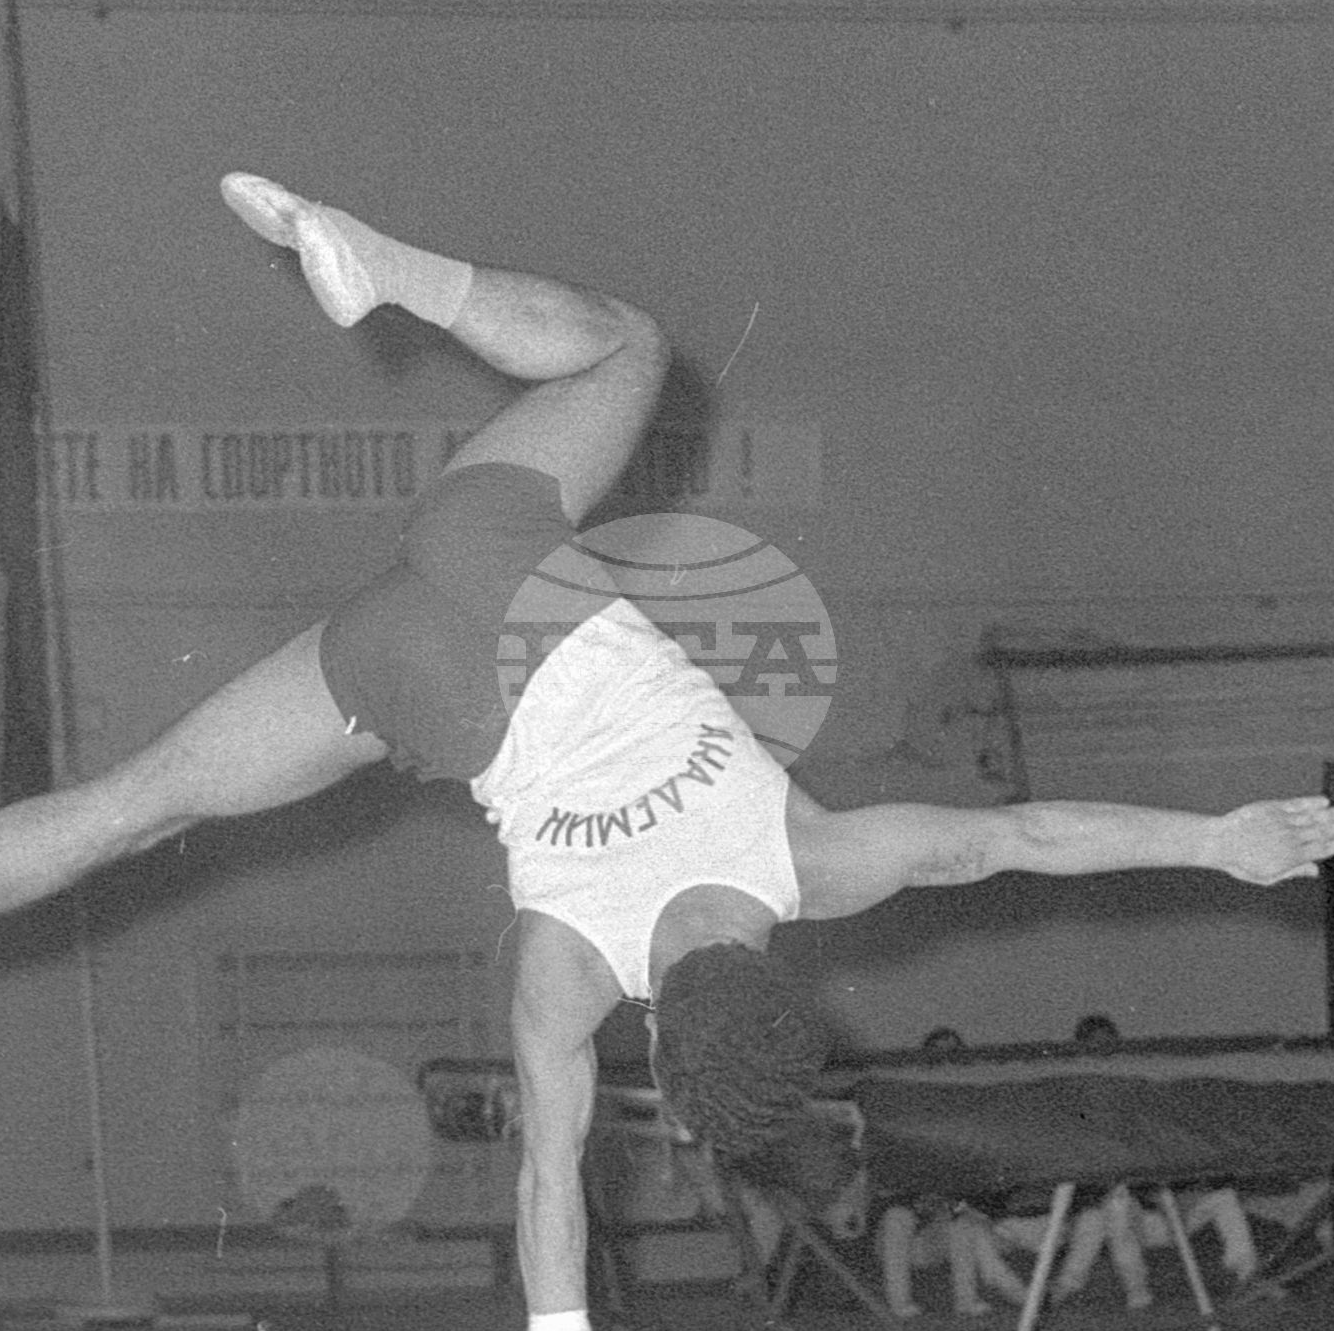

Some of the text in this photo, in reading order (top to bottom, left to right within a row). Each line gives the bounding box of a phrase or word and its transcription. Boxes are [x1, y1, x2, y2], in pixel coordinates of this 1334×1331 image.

[127, 432, 179, 501] НА
[201, 430, 415, 500] СПОРТНОТО
[535, 722, 734, 848] АКАДЕМИК
